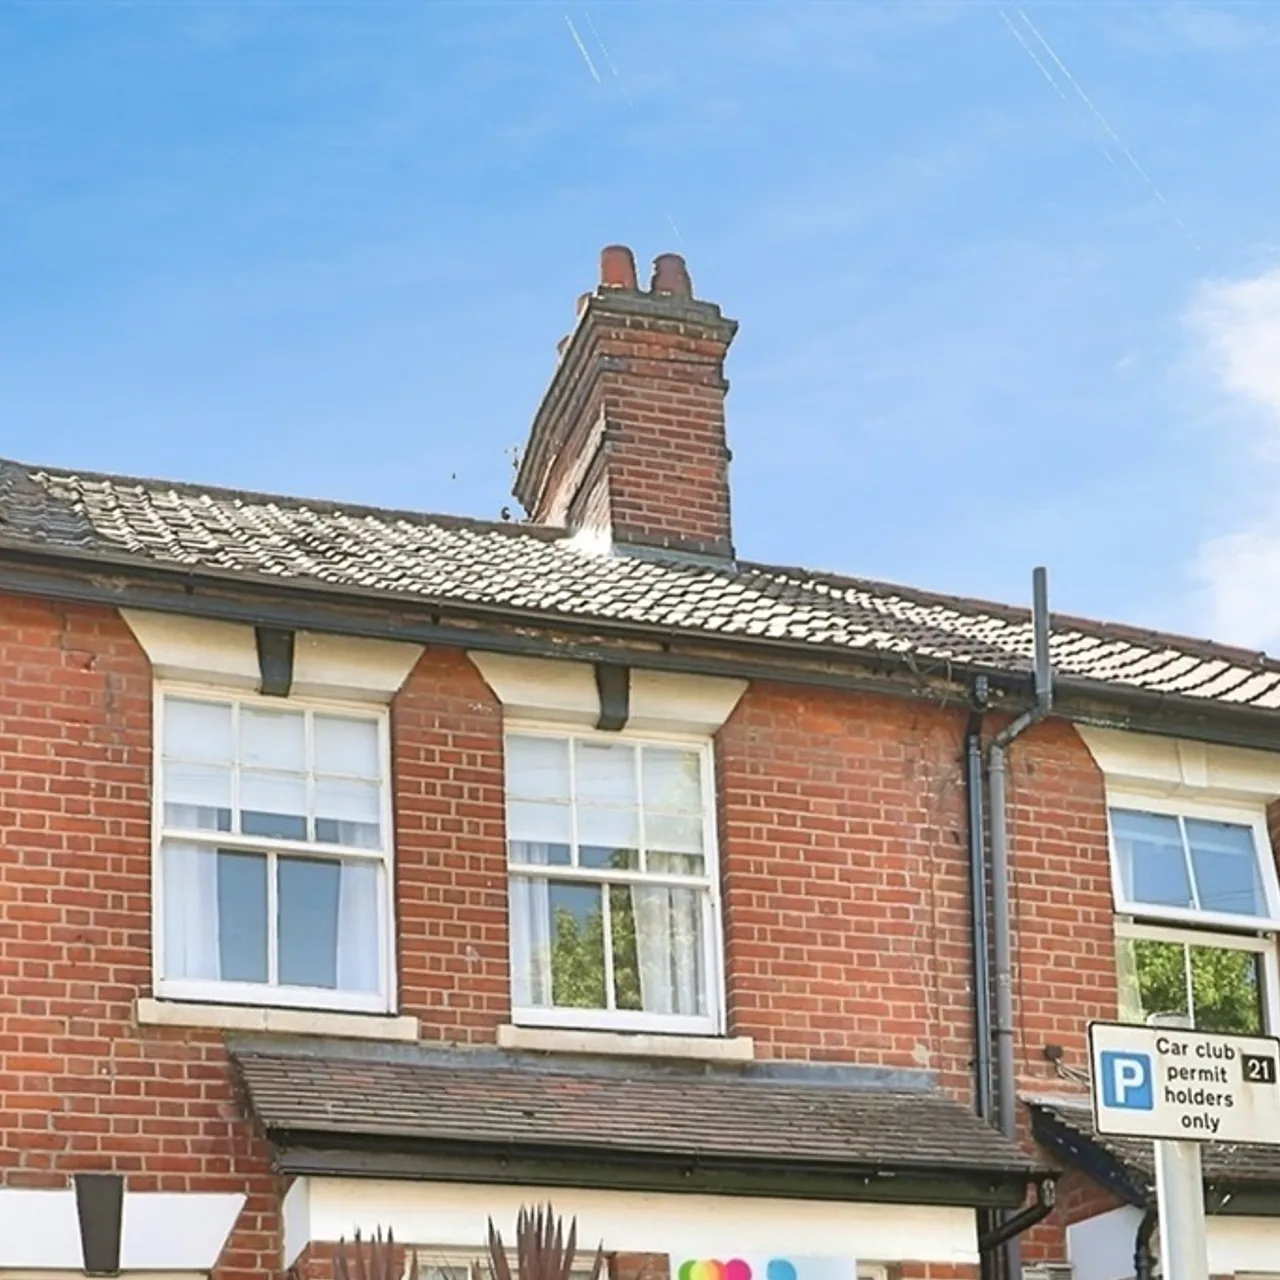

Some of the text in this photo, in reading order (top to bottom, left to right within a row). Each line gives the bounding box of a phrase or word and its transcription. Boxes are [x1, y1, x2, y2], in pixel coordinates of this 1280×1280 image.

[1156, 1037, 1236, 1060] Car club
[1167, 1065, 1228, 1083] permit
[1247, 1060, 1270, 1080] 21
[1112, 1058, 1145, 1103] P
[1165, 1087, 1234, 1108] holders
[1181, 1114, 1221, 1134] only
